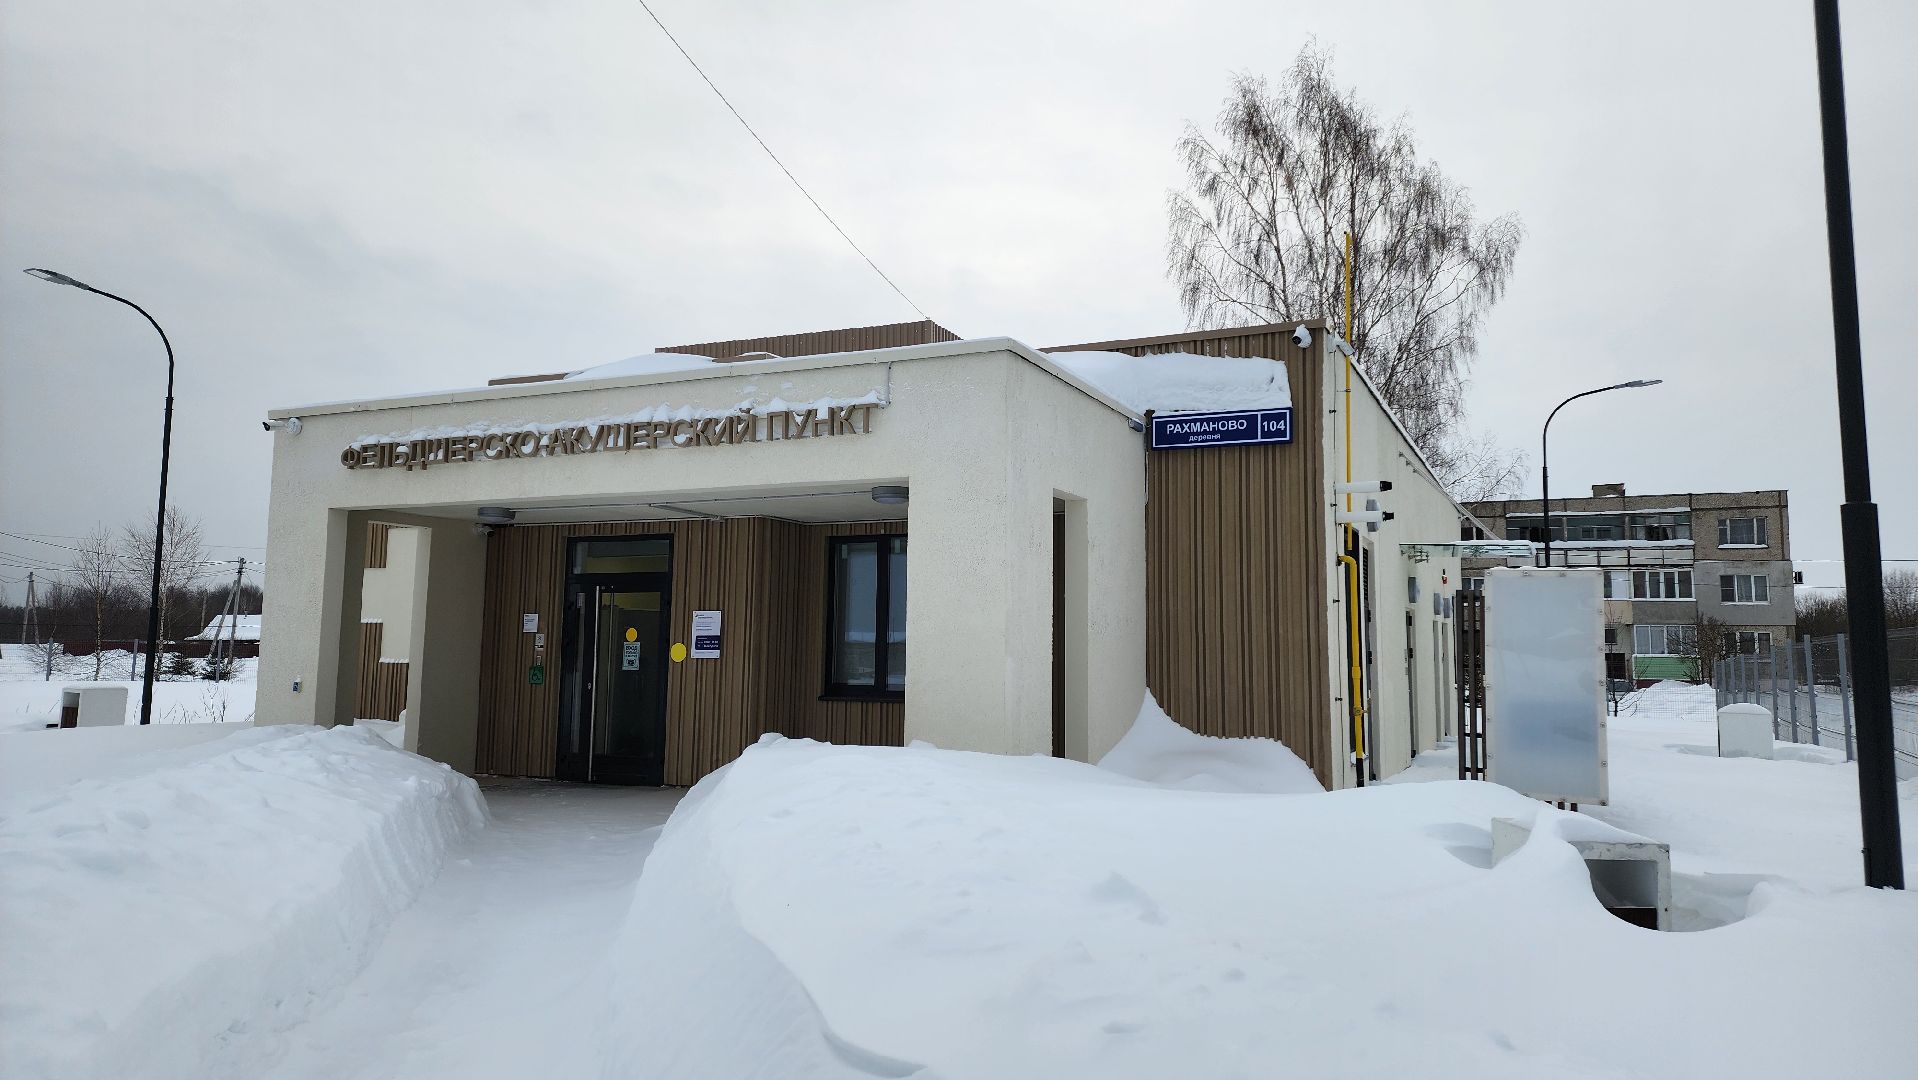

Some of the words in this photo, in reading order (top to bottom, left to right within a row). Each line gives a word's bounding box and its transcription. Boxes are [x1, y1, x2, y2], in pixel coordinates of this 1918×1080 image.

[1166, 419, 1248, 435] РАХМАНОВО
[1262, 419, 1286, 432] 104
[340, 406, 759, 471] ФЕЛЬДШЕРСКО-АКУШЕРСКИЙ
[766, 403, 879, 442] ПУНКТ
[1188, 433, 1221, 442] деревня
